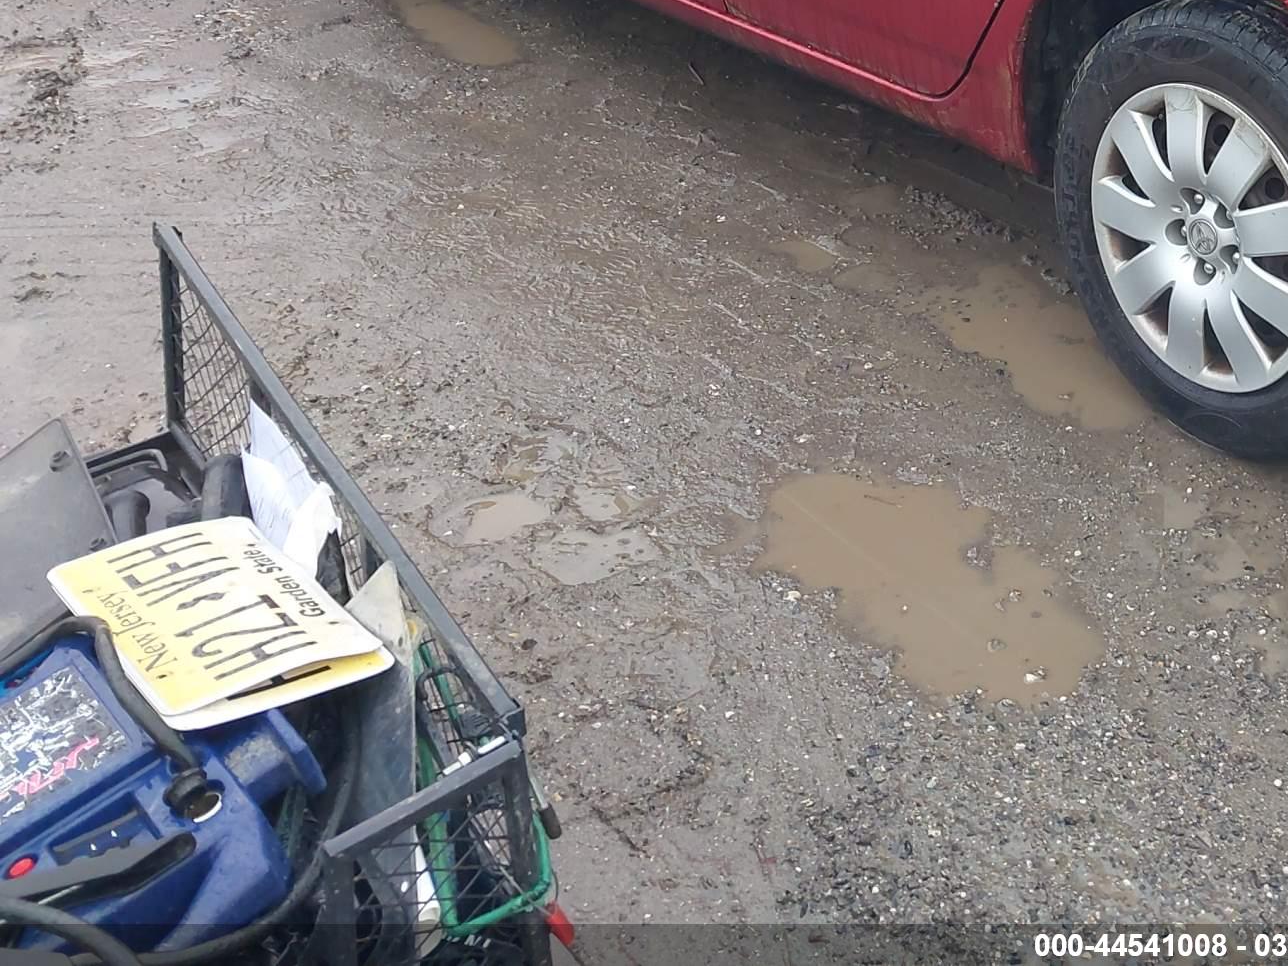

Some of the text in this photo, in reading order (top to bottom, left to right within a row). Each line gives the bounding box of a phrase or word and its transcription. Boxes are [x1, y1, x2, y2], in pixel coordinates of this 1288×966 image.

[107, 532, 317, 682] H21 VFH
[242, 547, 326, 618] Garden State
[98, 586, 178, 674] New Jersey
